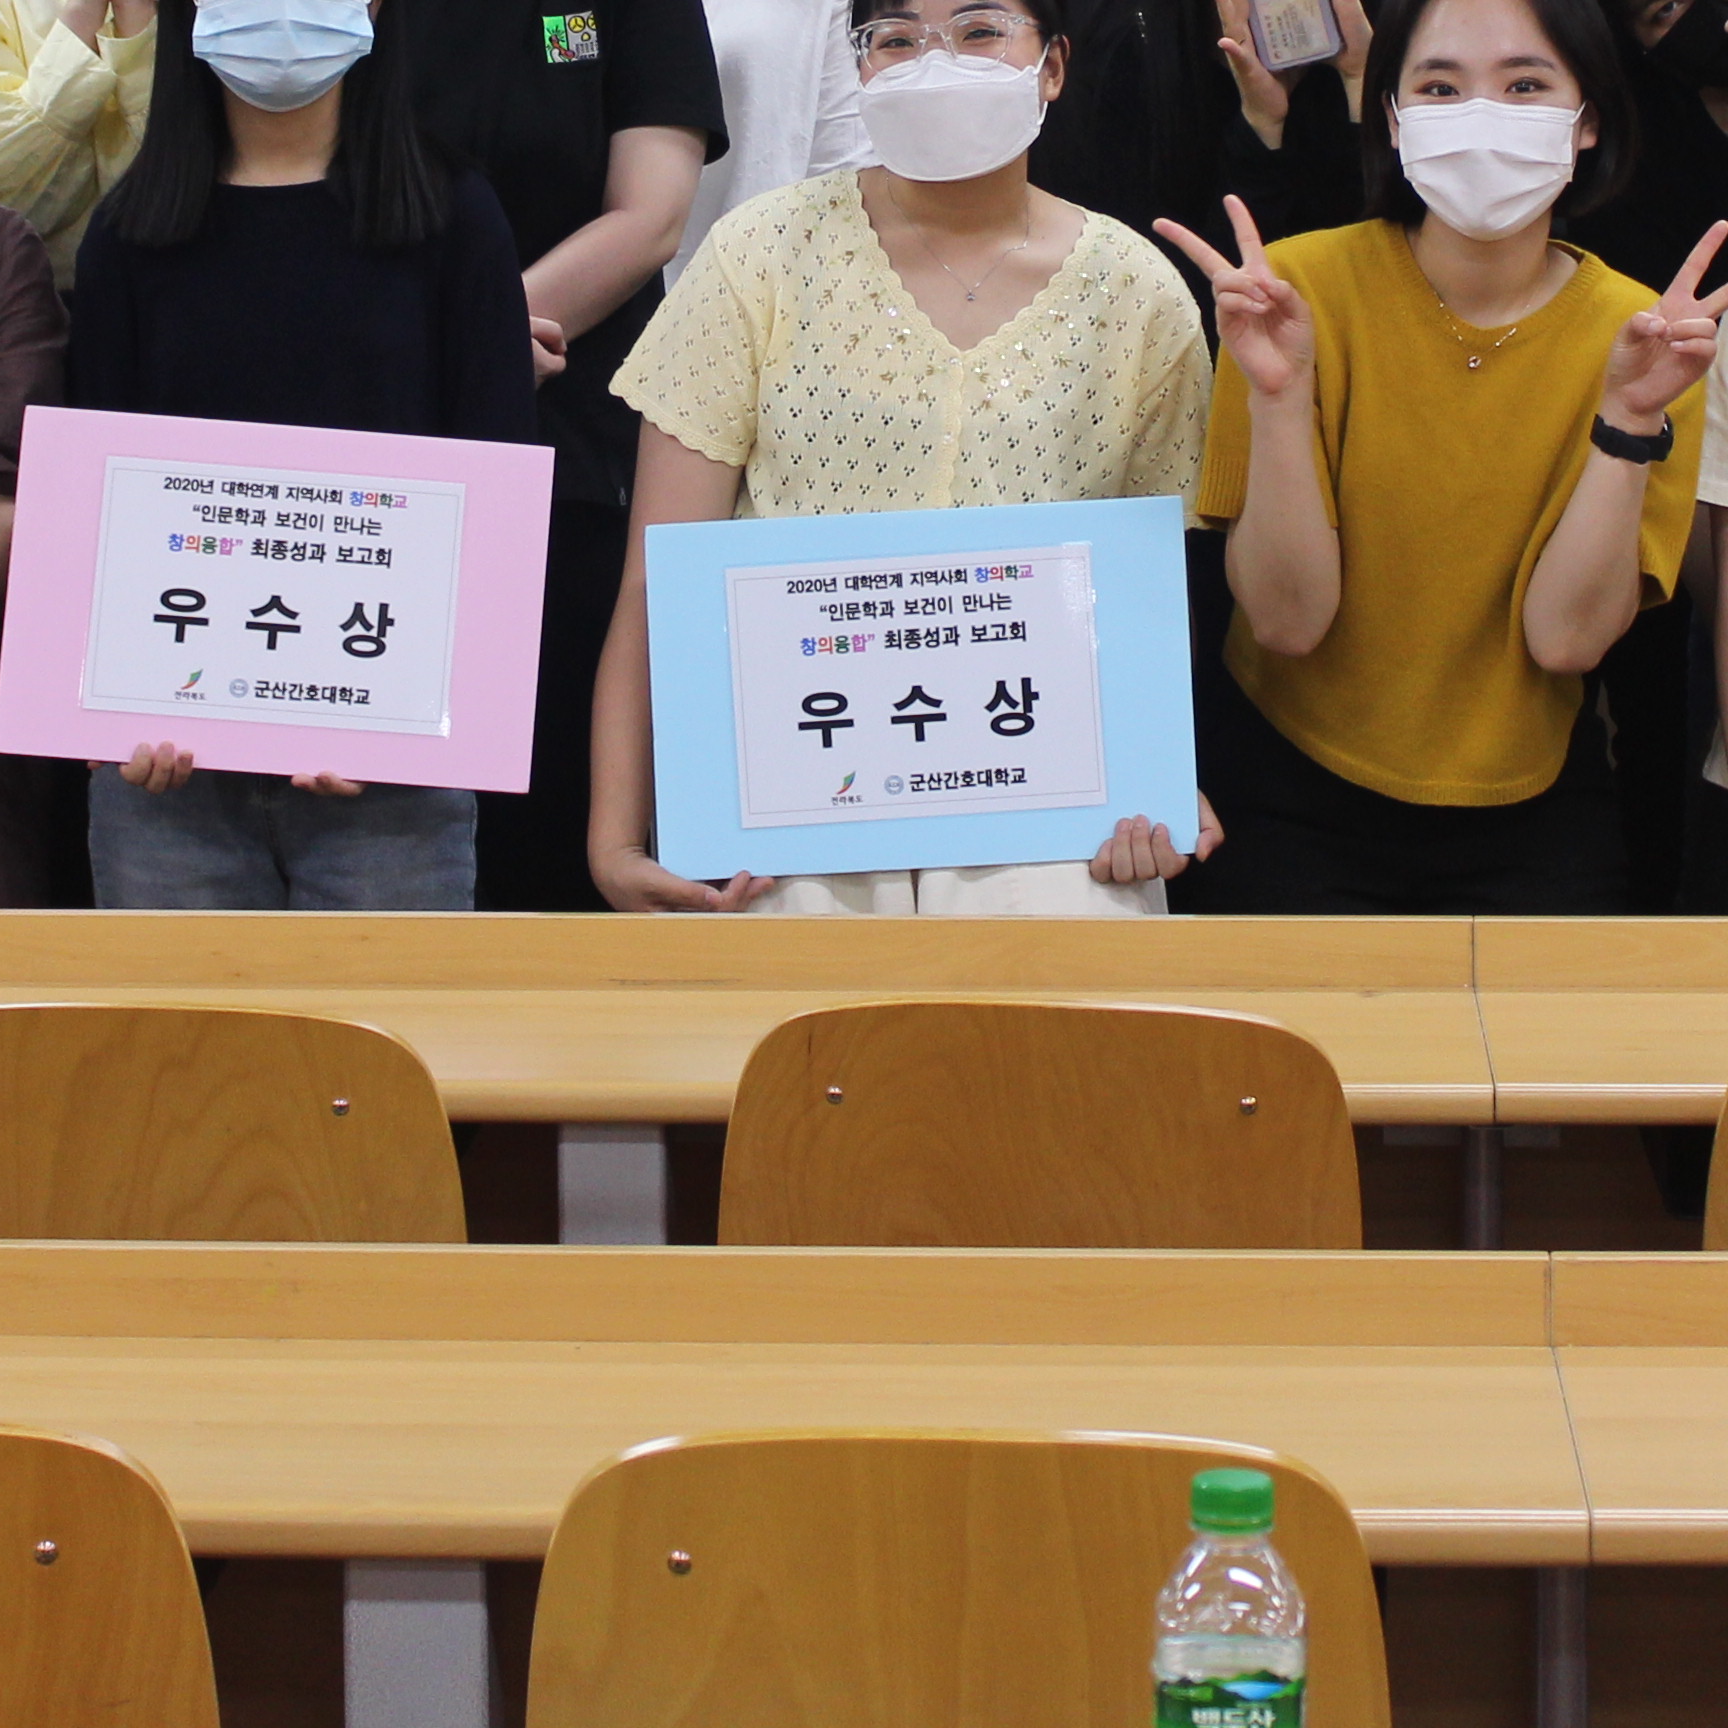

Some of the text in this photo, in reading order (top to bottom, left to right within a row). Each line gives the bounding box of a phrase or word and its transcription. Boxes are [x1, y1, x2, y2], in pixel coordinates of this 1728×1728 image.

[163, 477, 407, 510] 2020년 대학연계 지역사회 창의학교
[193, 504, 382, 537] “인문학과 보건이 만나는
[168, 534, 392, 568] 창의융합” 최종성과 보고회
[786, 564, 1034, 595] 2020년 대학연계 지역사회 창의학교
[819, 591, 1012, 623] “인문학과 보건이 만나는
[800, 621, 1027, 656] 창의융합” 최종성과 보고회
[254, 680, 371, 707] 군산간호대학교
[908, 765, 1027, 794] 군산간호대학교
